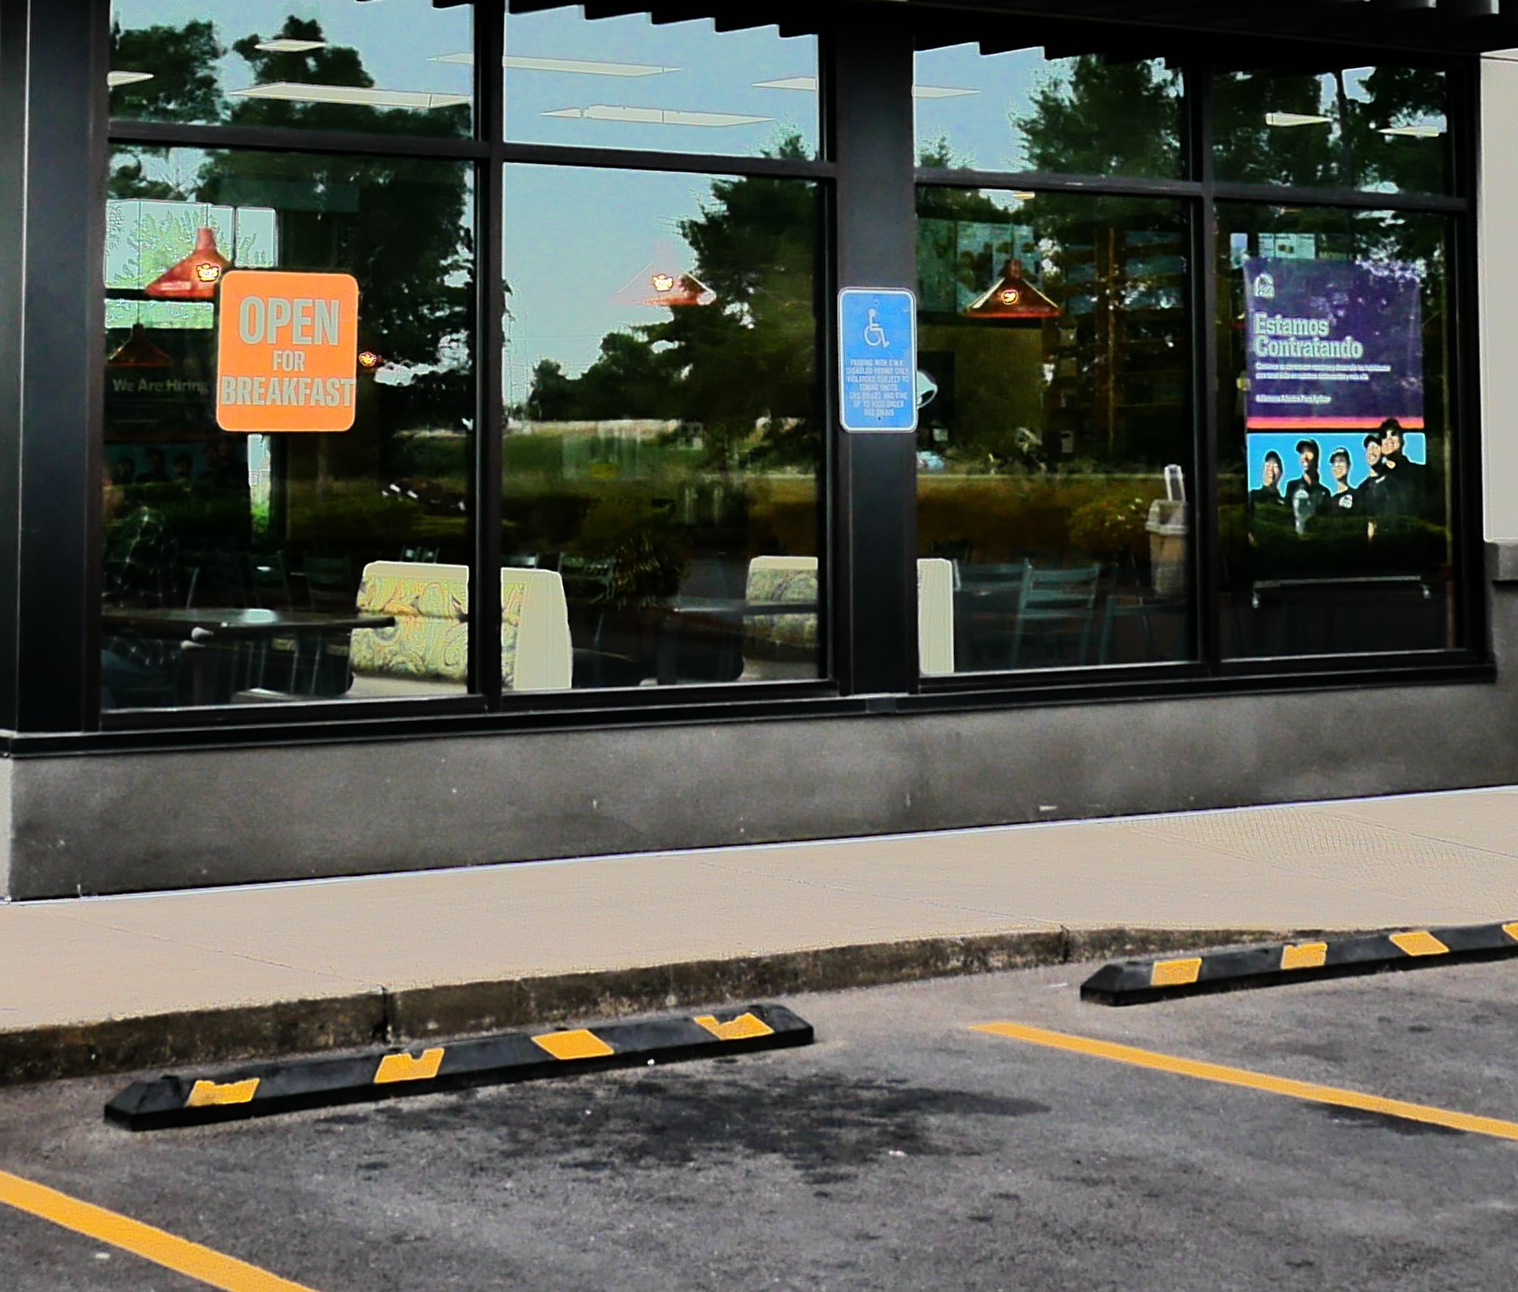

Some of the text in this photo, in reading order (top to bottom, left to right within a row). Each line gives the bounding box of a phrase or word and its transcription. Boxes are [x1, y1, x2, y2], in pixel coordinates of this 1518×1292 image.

[238, 295, 340, 345] OPEN
[1253, 311, 1330, 337] Estamos
[1253, 335, 1364, 358] Contratando
[272, 349, 306, 372] FOR
[112, 378, 209, 395] We Are Hiring
[221, 375, 356, 407] BREAKFAST
